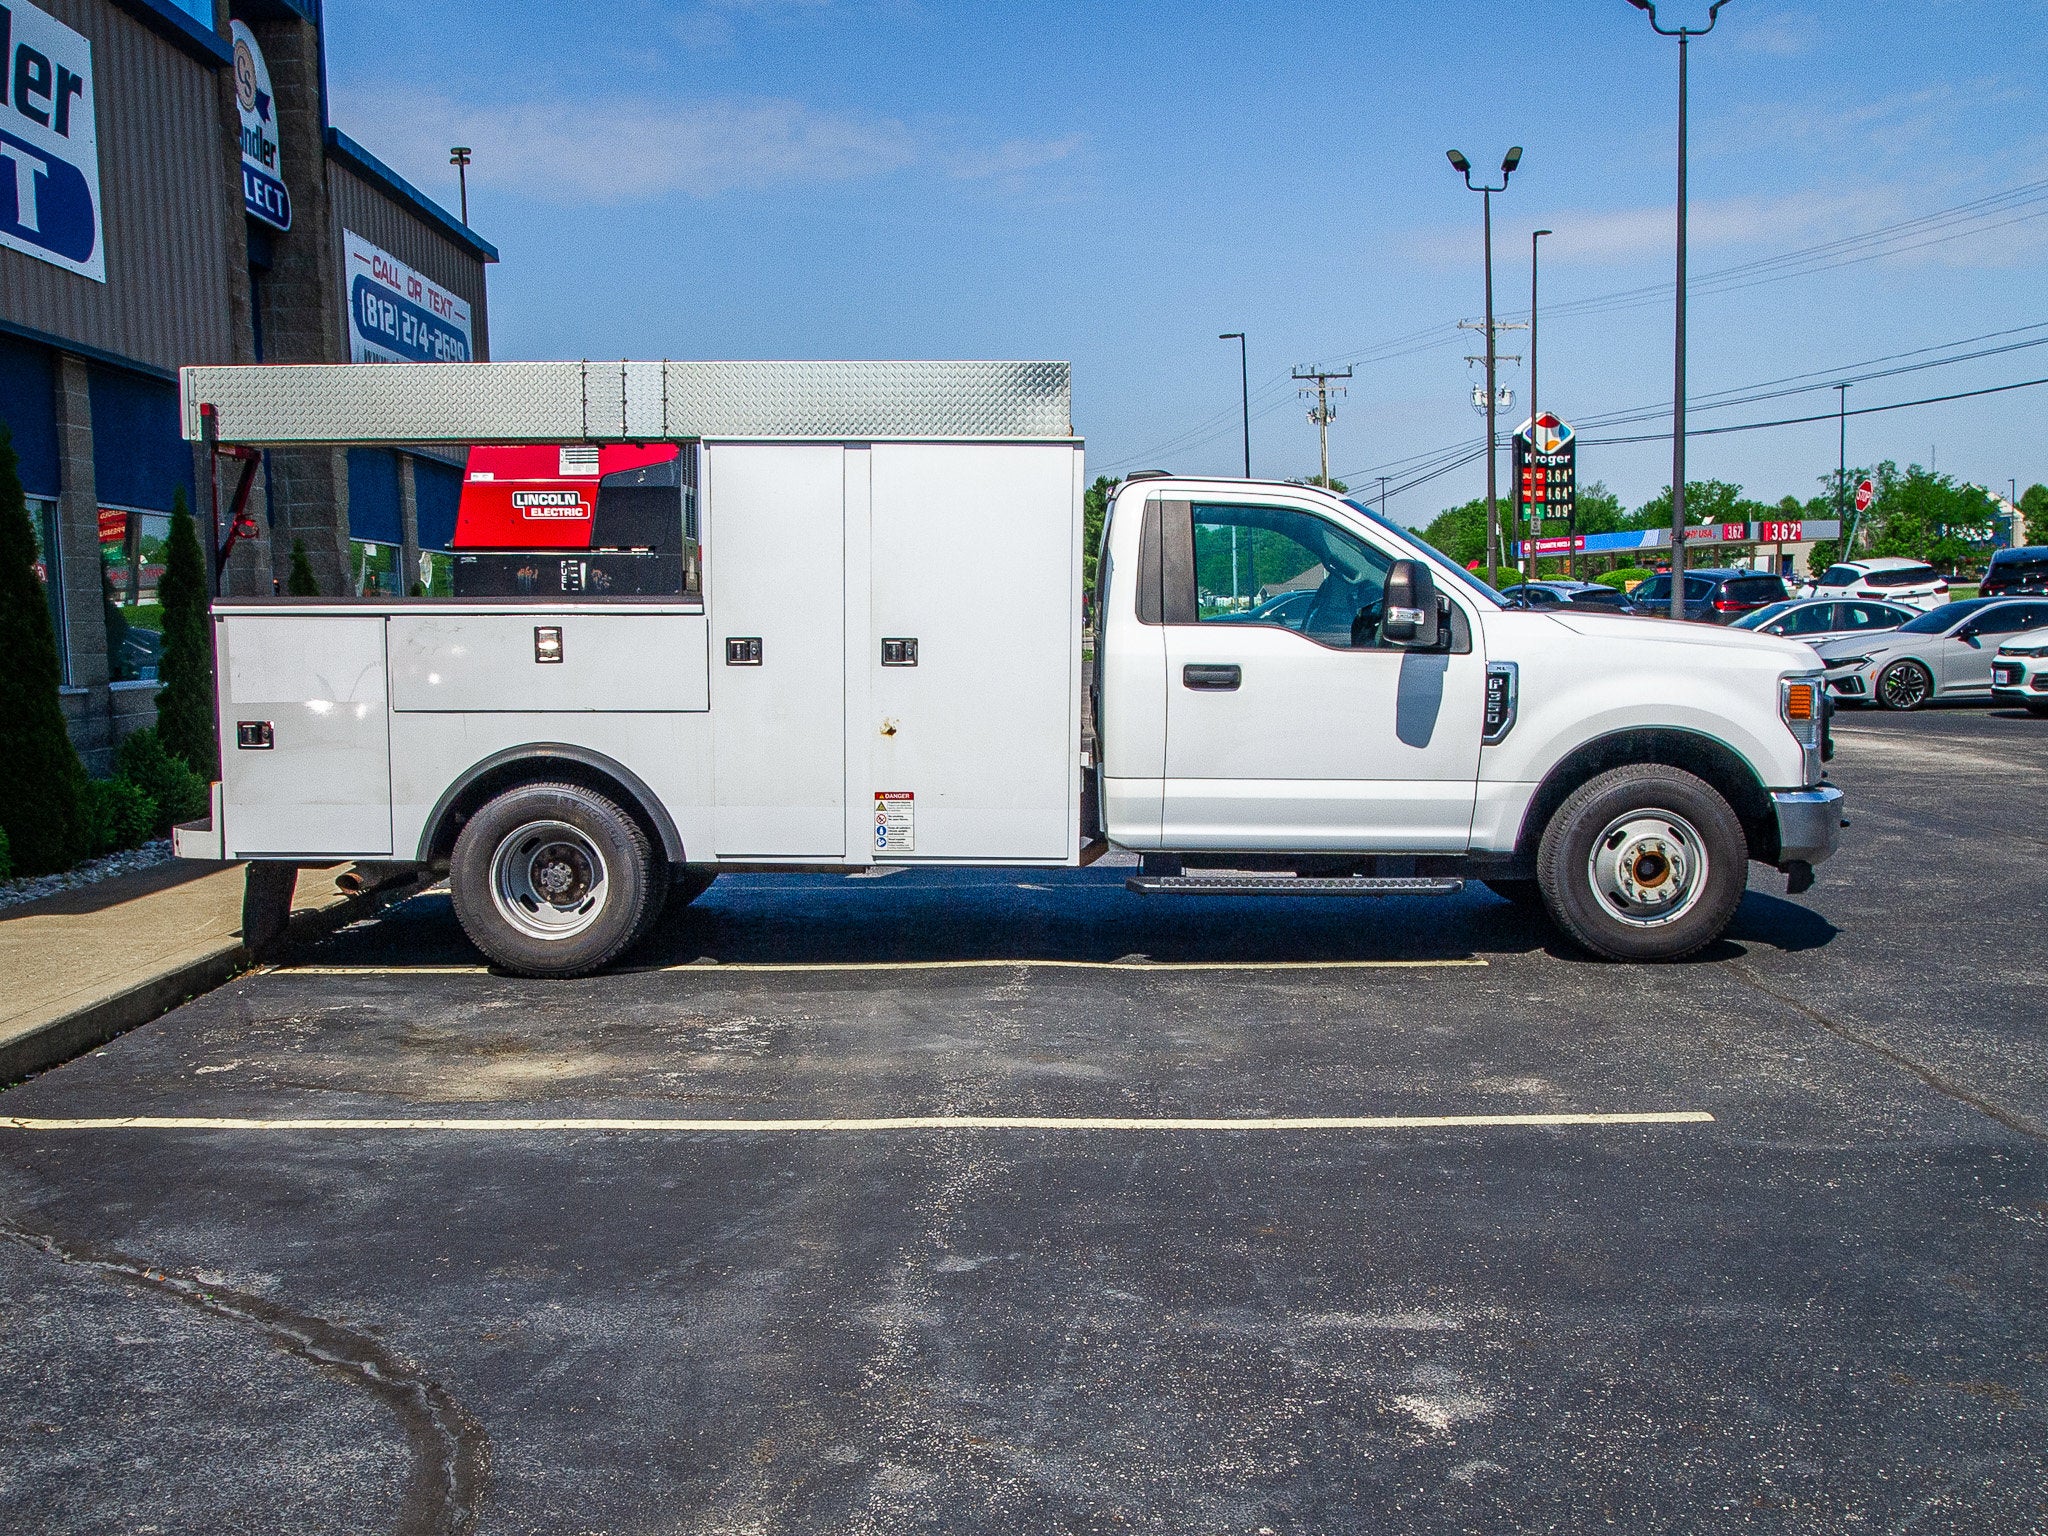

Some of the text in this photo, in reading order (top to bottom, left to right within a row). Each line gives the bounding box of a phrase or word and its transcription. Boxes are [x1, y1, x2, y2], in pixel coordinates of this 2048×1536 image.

[372, 254, 453, 320] CALL OR TEXT
[361, 288, 399, 341] (812)
[1525, 452, 1570, 466] Kroger
[516, 493, 577, 506] LINCOLN
[1857, 489, 1871, 503] STOP
[530, 507, 584, 517] ELECTRIC
[560, 560, 568, 591] FUEL
